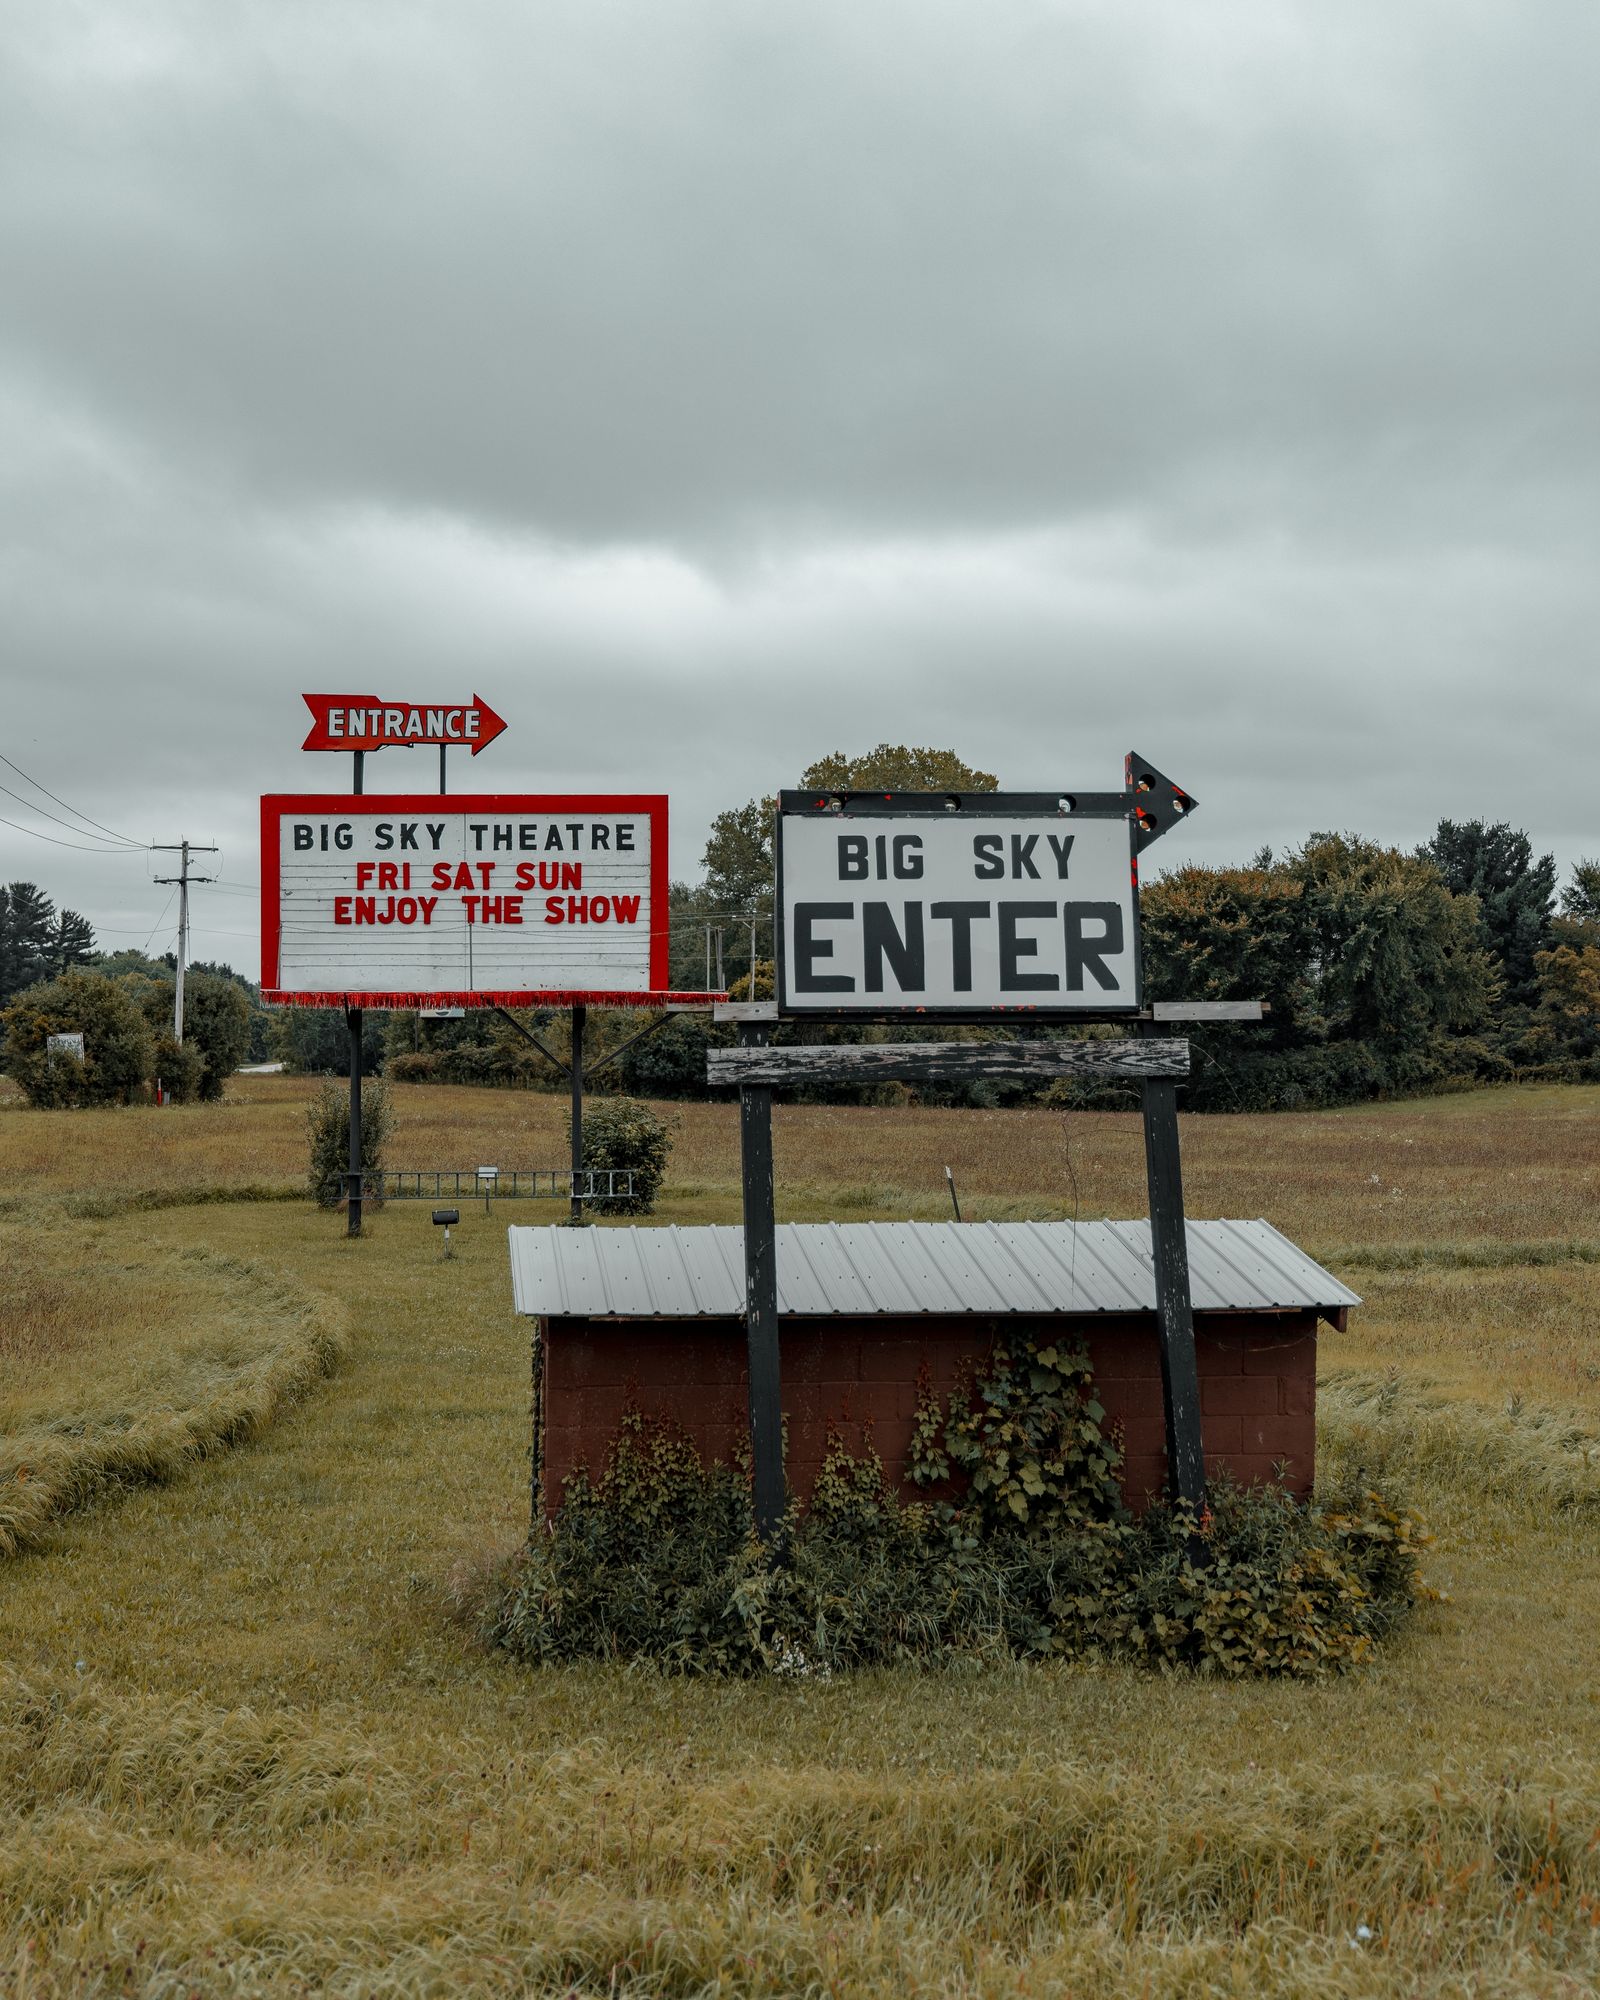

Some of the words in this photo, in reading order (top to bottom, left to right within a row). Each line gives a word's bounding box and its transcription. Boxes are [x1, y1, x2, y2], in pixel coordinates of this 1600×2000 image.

[327, 708, 481, 738] ENTRANCE
[293, 824, 353, 852] BIG
[374, 823, 446, 851] SKY
[470, 823, 635, 851] THEATRE
[837, 834, 924, 881] BIG
[973, 834, 1075, 880] SKY
[356, 862, 411, 891] FRI
[431, 862, 496, 891] SAT
[514, 862, 582, 891] SUN
[334, 896, 438, 925] ENJOY
[462, 896, 523, 925] THE
[544, 895, 641, 925] SHOW
[793, 901, 1124, 993] ENTER
